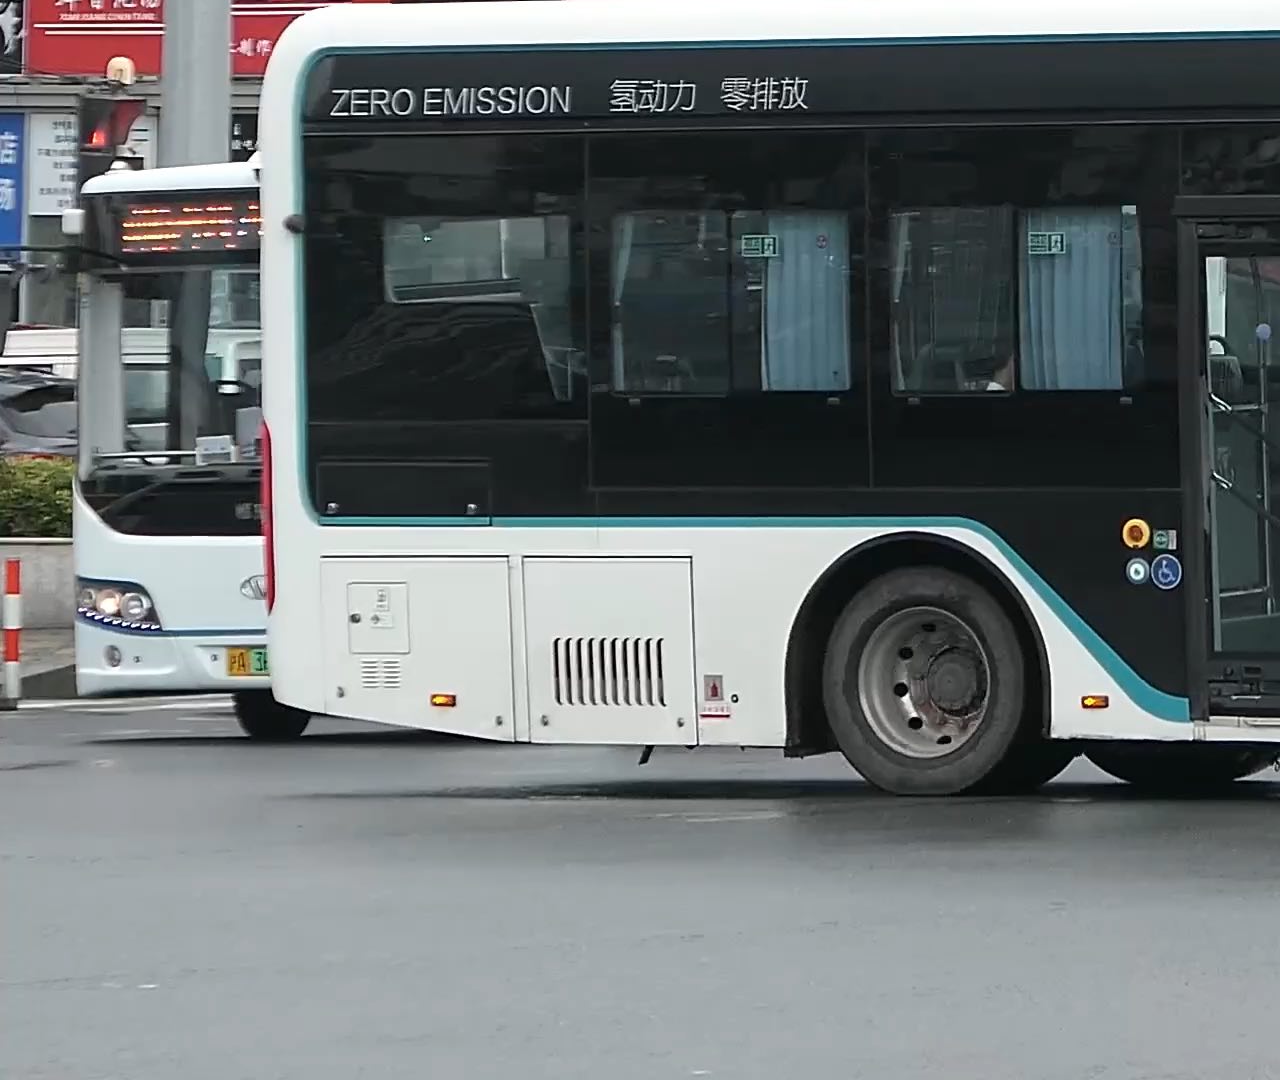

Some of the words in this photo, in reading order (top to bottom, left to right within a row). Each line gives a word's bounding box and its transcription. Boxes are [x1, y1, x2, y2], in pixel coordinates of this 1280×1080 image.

[330, 88, 416, 118] ZERO
[423, 85, 571, 117] EMISSION
[609, 78, 697, 113] 氢动力
[720, 76, 809, 111] 零排放
